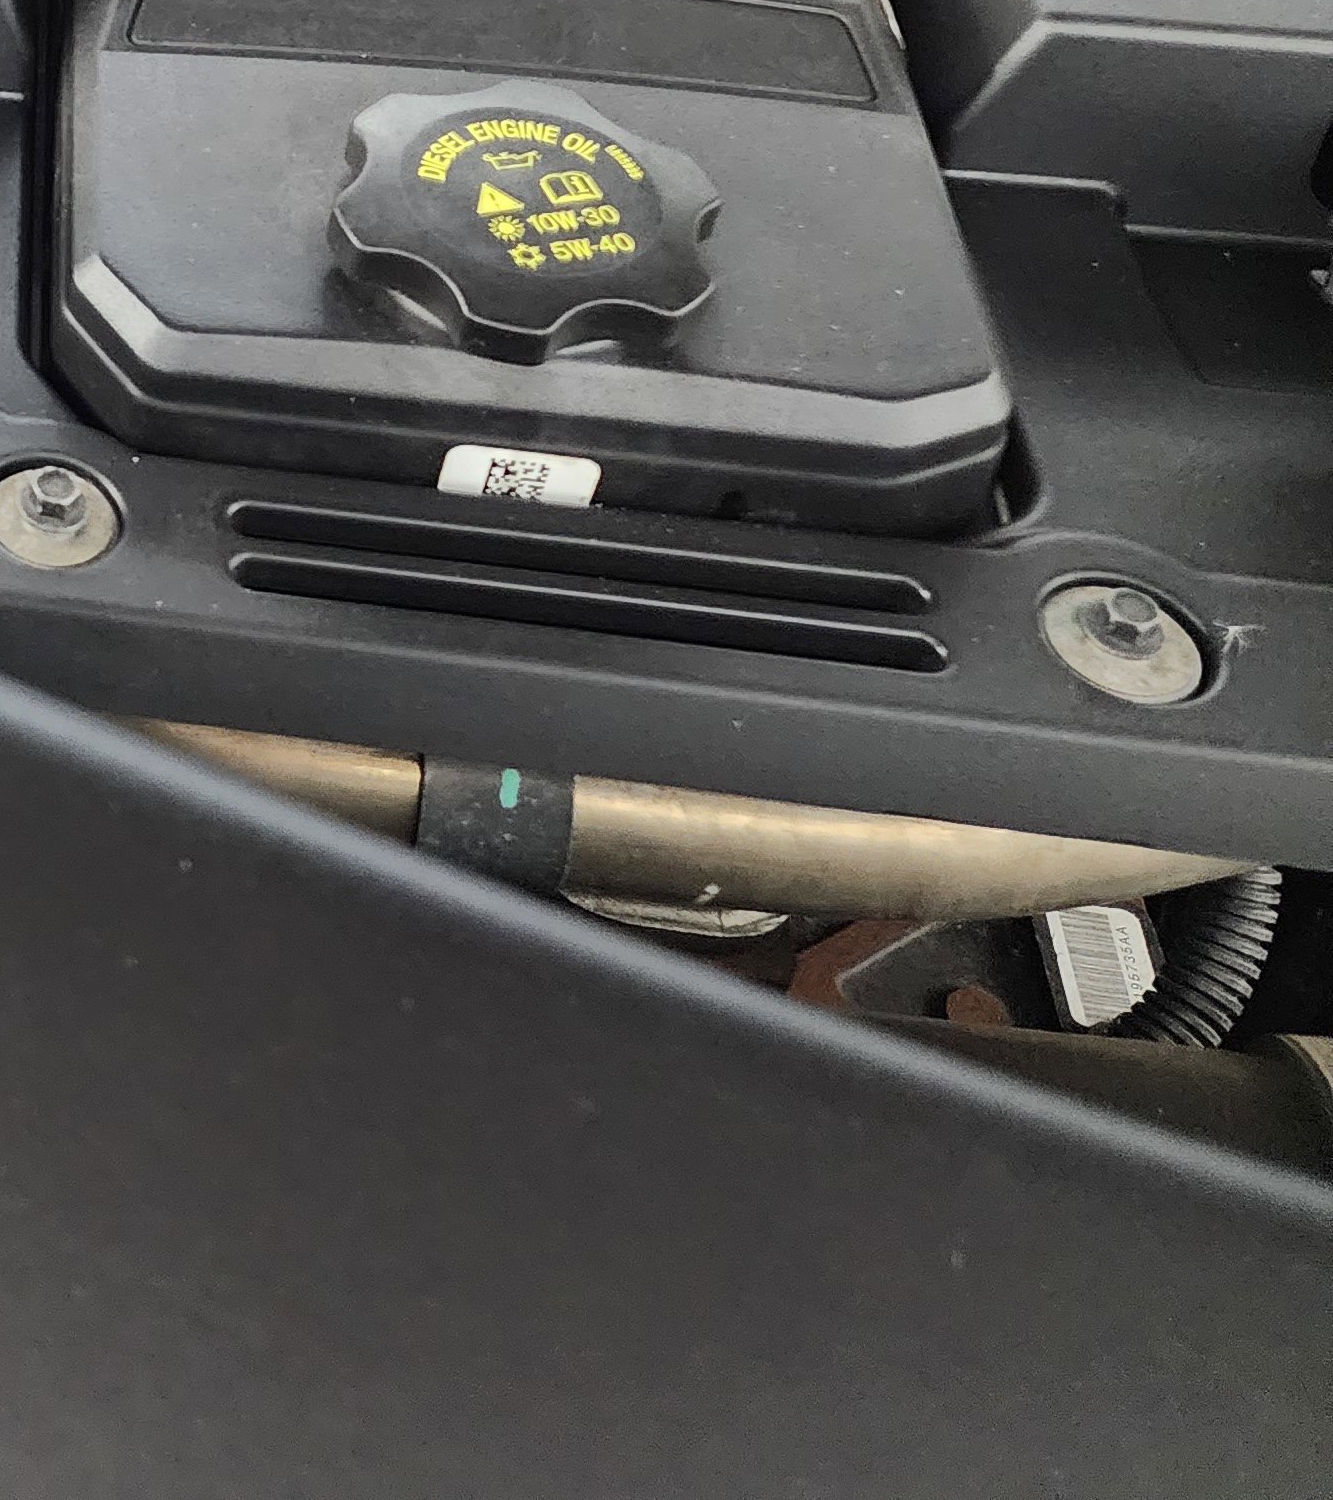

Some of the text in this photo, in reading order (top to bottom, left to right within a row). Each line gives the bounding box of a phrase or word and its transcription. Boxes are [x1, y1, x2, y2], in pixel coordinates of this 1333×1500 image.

[418, 131, 475, 182] DIESEL
[465, 118, 561, 145] ENGINE
[561, 133, 600, 164] OIL
[527, 204, 620, 234] 10W-30
[549, 232, 636, 262] 5W-40
